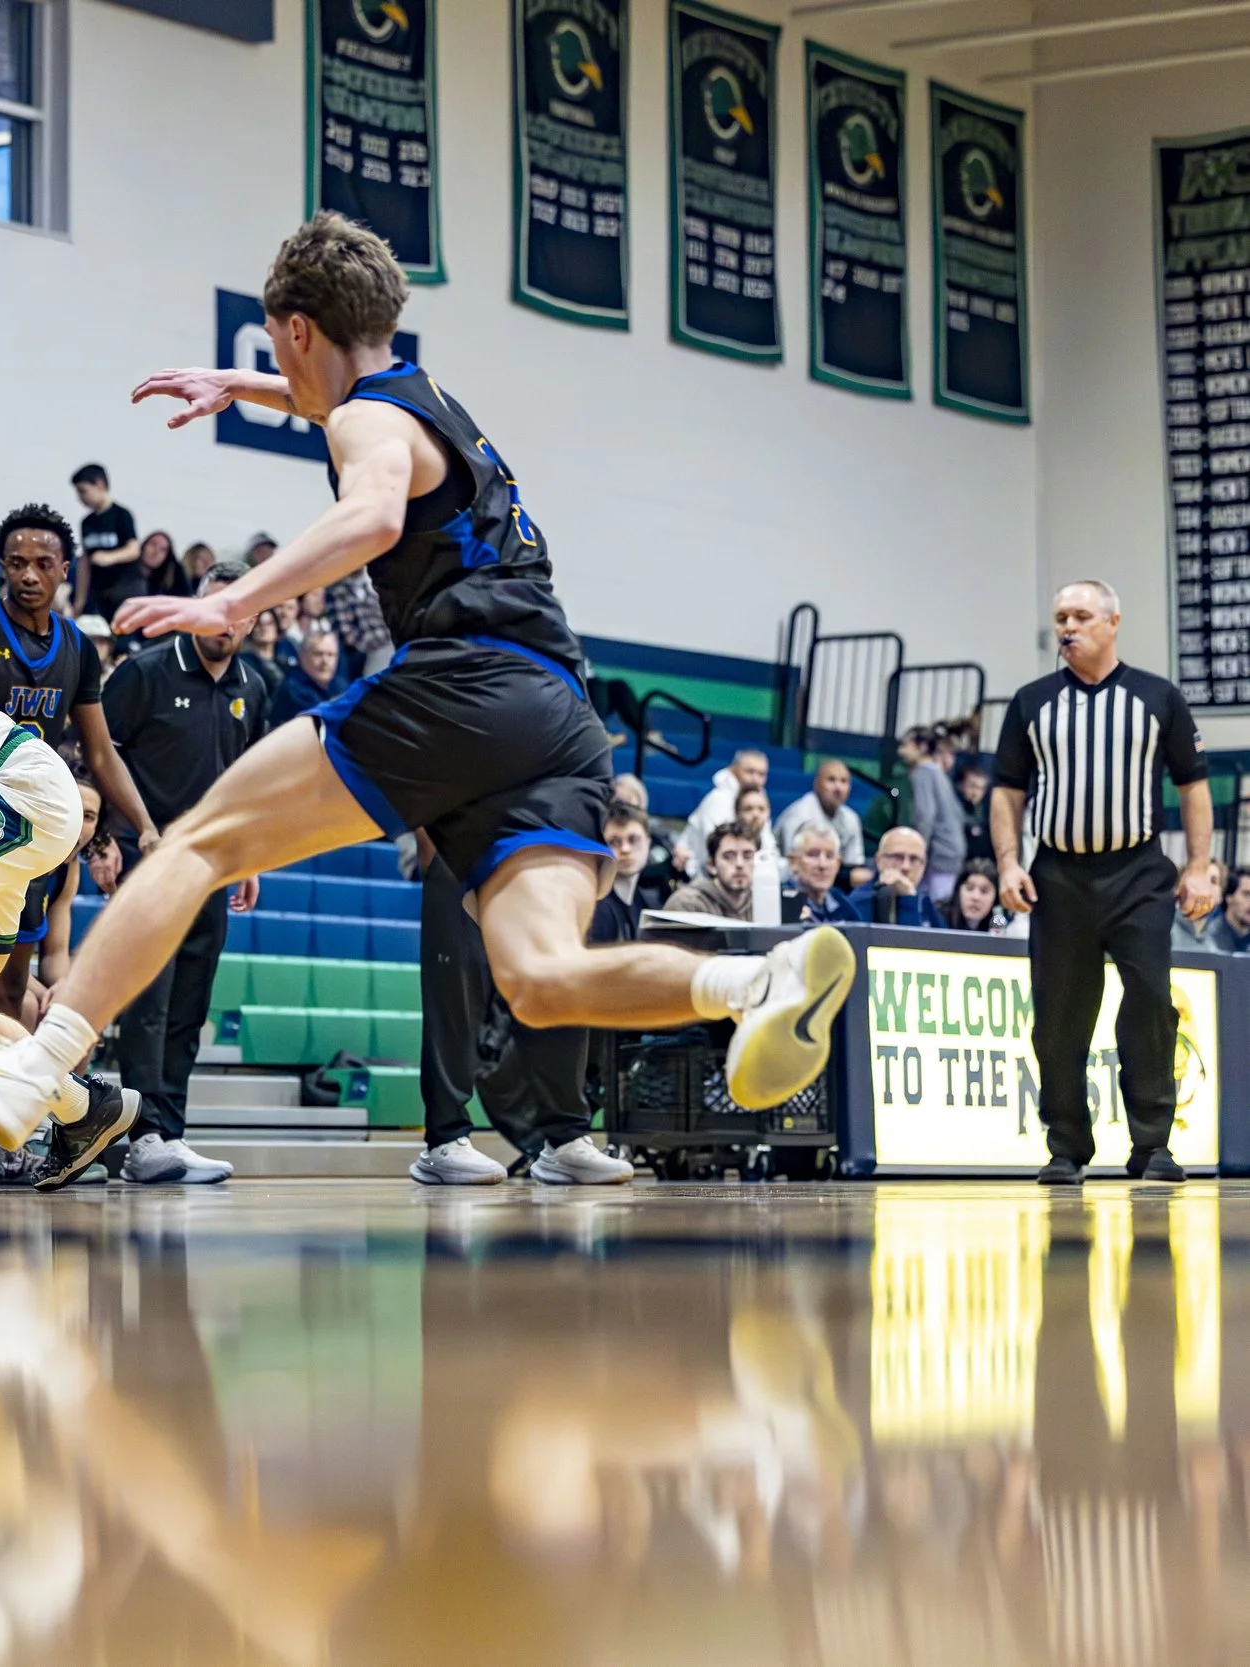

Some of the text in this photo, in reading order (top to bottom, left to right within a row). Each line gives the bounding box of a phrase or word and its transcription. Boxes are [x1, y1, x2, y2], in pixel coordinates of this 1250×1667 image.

[5, 686, 62, 718] JWU
[868, 969, 1035, 1038] WELCOM
[877, 1045, 1119, 1134] TO THE NST
